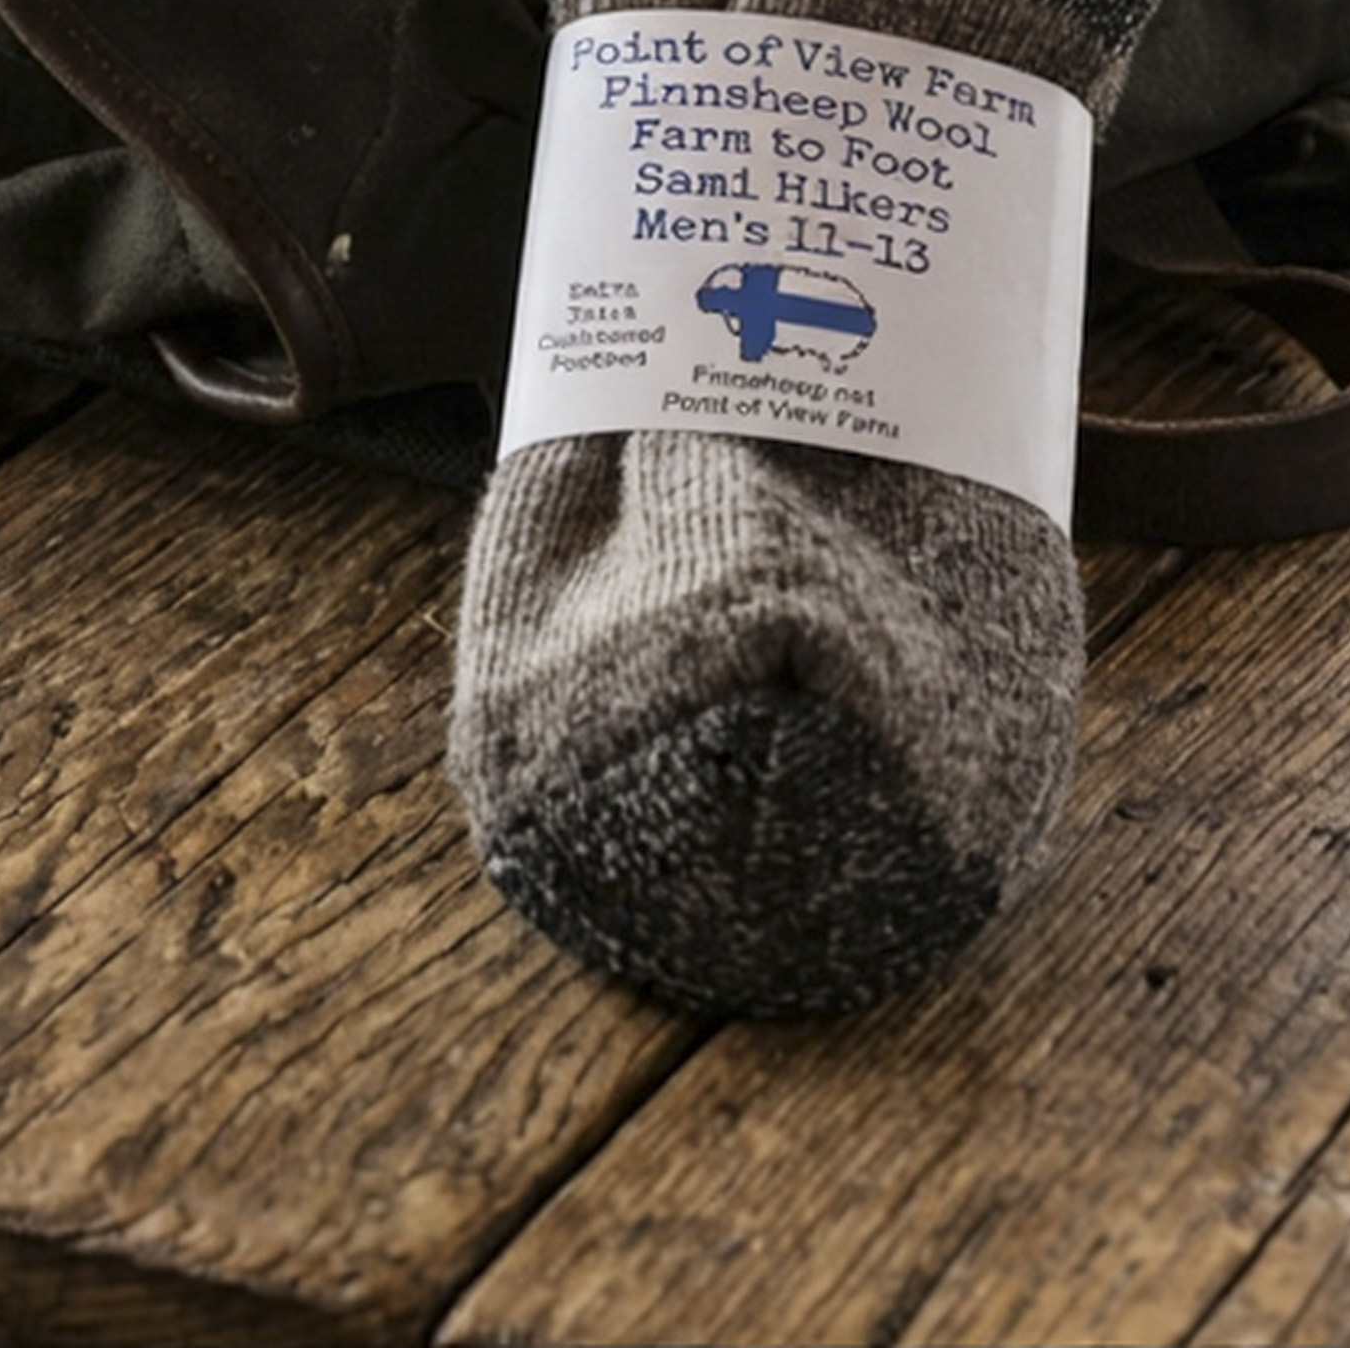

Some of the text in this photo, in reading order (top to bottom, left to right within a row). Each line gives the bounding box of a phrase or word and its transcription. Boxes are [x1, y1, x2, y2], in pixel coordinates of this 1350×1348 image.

[570, 29, 1037, 128] Point of View Farm
[629, 117, 955, 192] Farm to Foot
[882, 98, 999, 159] Wool
[632, 206, 933, 276] Men's 11-13
